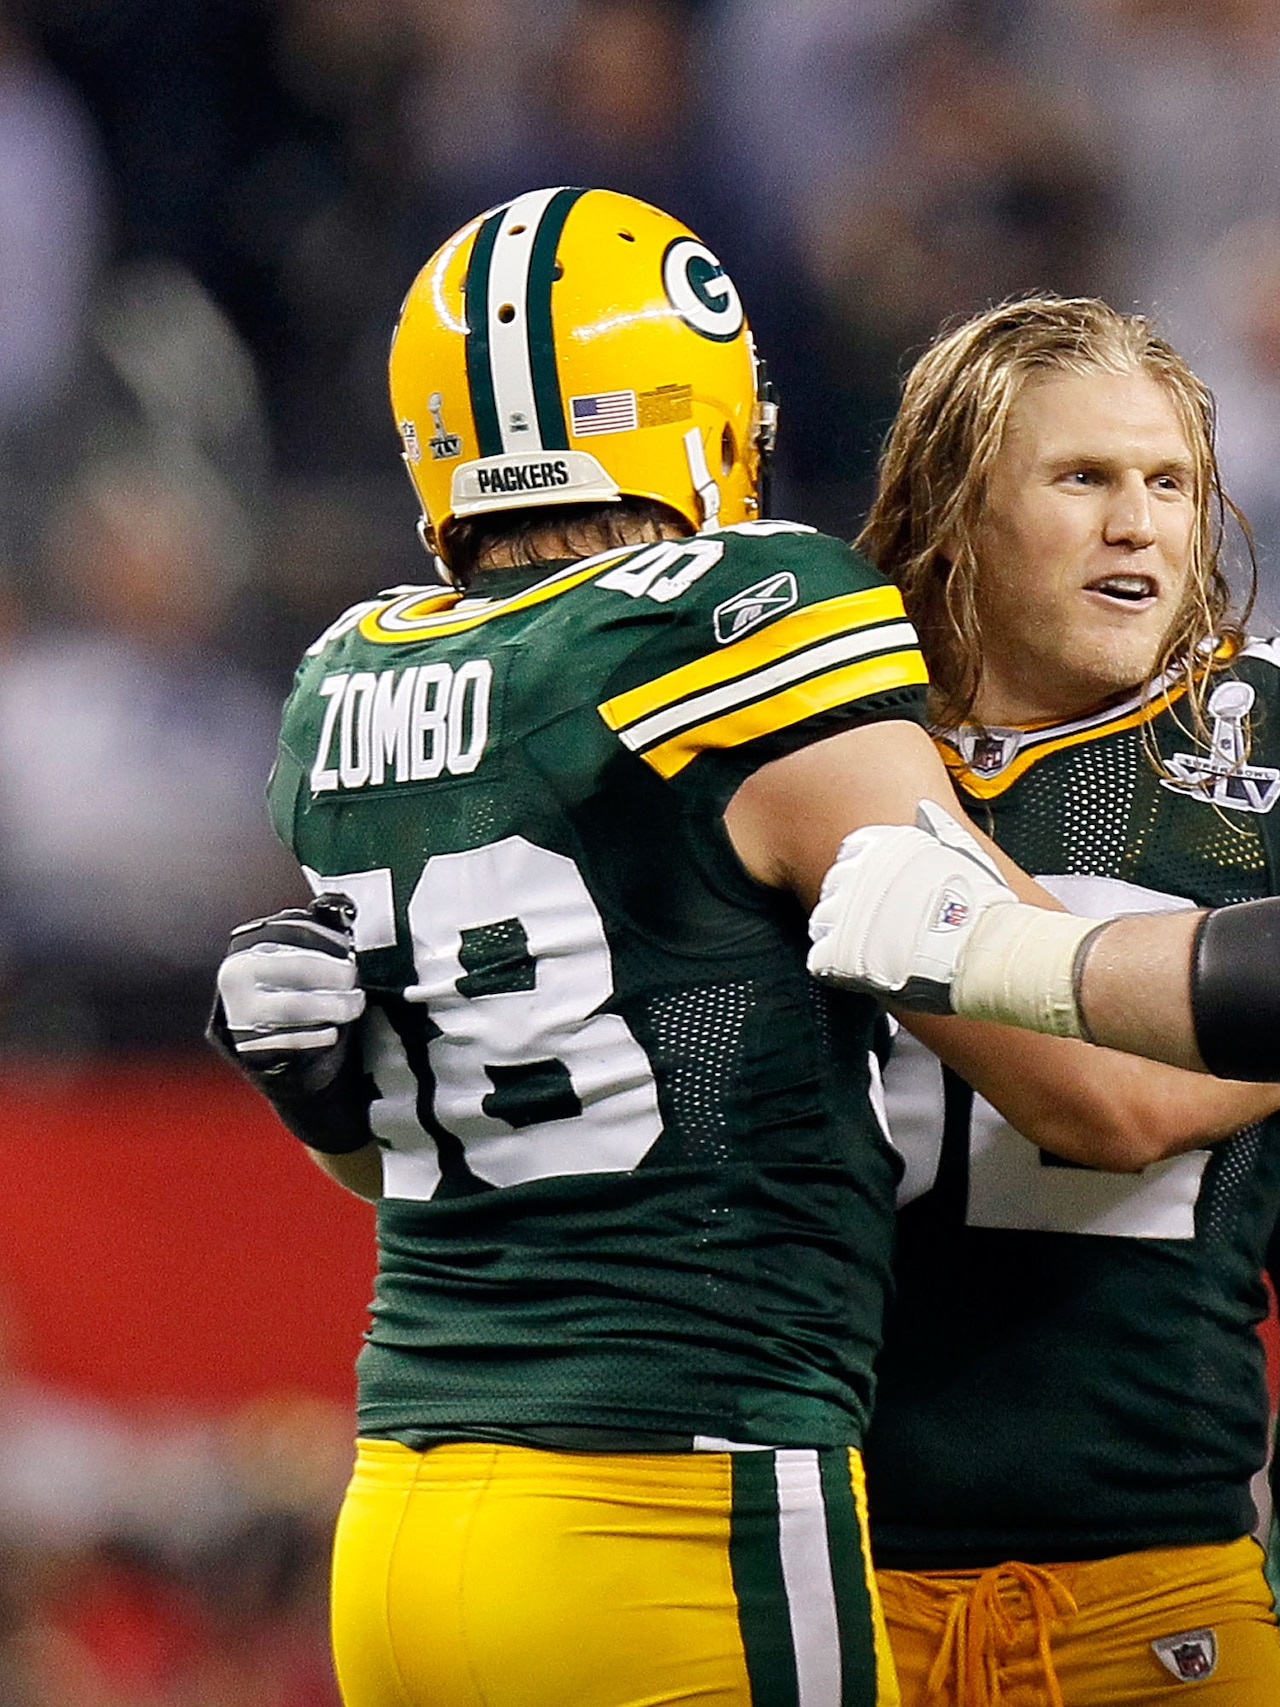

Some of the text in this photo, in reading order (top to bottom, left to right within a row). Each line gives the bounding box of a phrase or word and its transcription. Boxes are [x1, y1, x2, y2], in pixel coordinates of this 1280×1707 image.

[662, 237, 743, 338] G
[476, 460, 569, 494] PACKERS
[310, 659, 494, 793] ZOMBO
[1236, 766, 1272, 780] BOWL
